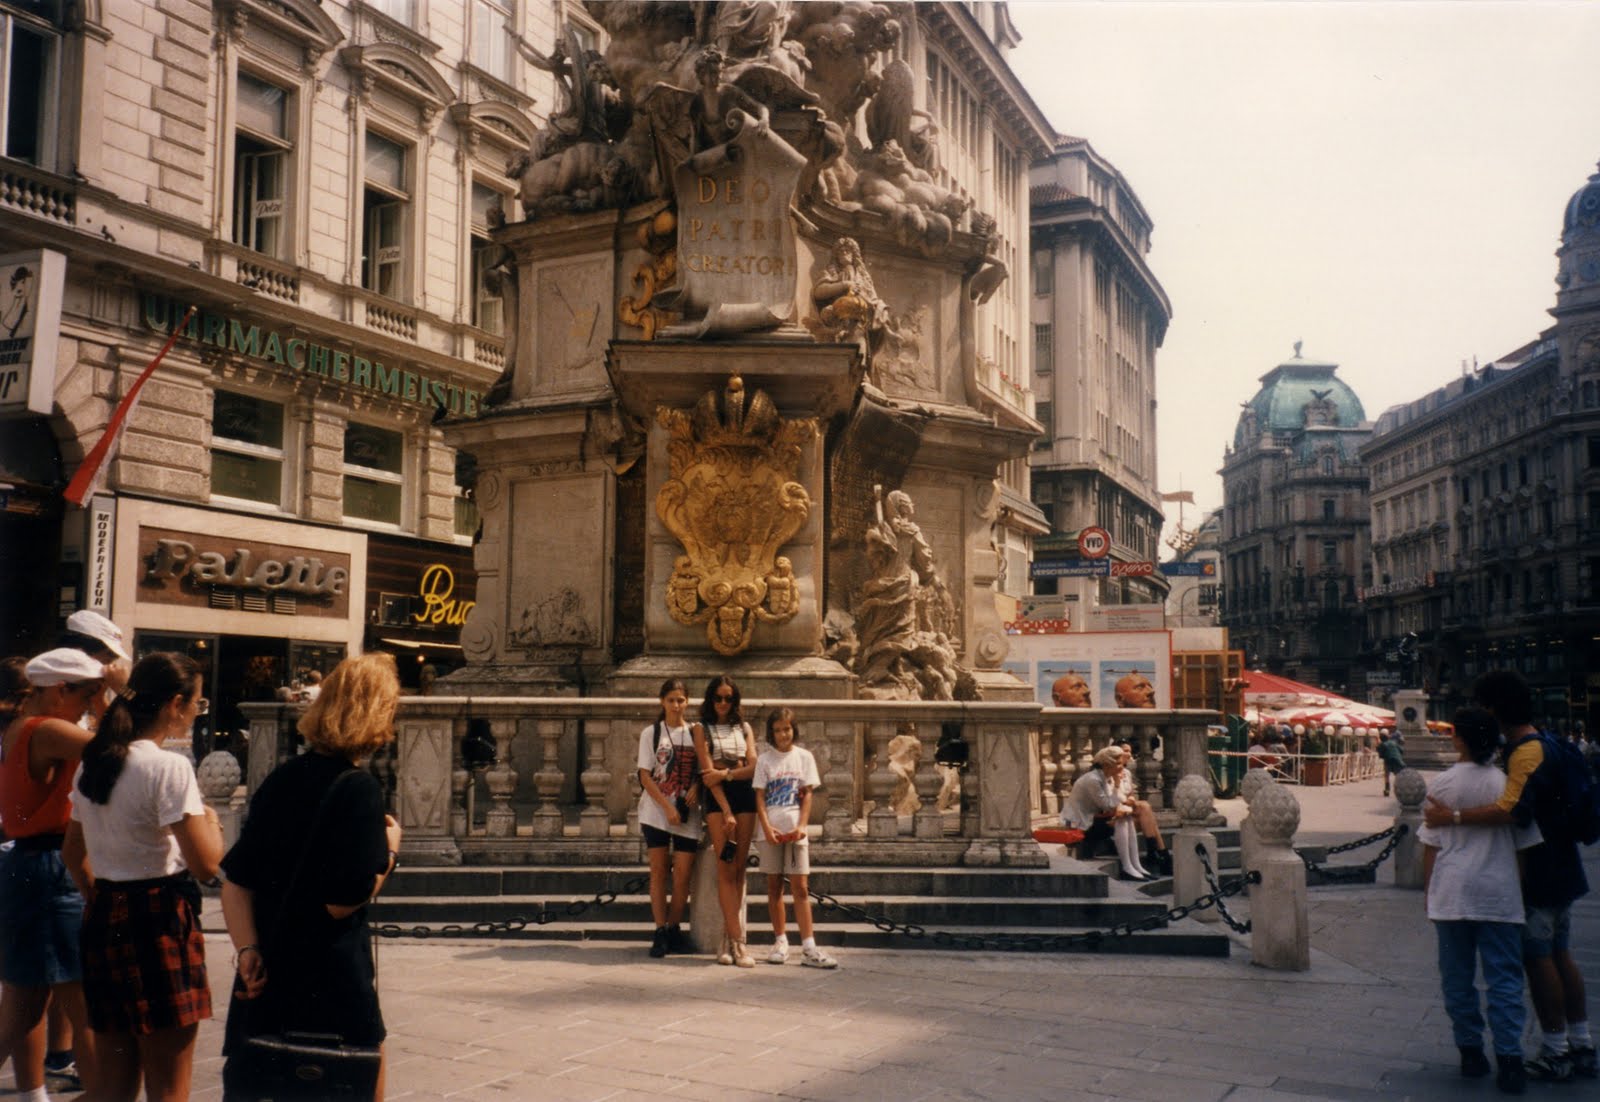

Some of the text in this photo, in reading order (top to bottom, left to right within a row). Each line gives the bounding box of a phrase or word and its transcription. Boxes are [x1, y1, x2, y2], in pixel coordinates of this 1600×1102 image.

[696, 176, 771, 205] DEO
[688, 217, 783, 242] PATRI
[686, 254, 795, 276] CREATORI
[144, 294, 489, 417] UHRMACHERMEISTE
[94, 513, 110, 606] MODEFRISEUR
[148, 538, 348, 595] Palette
